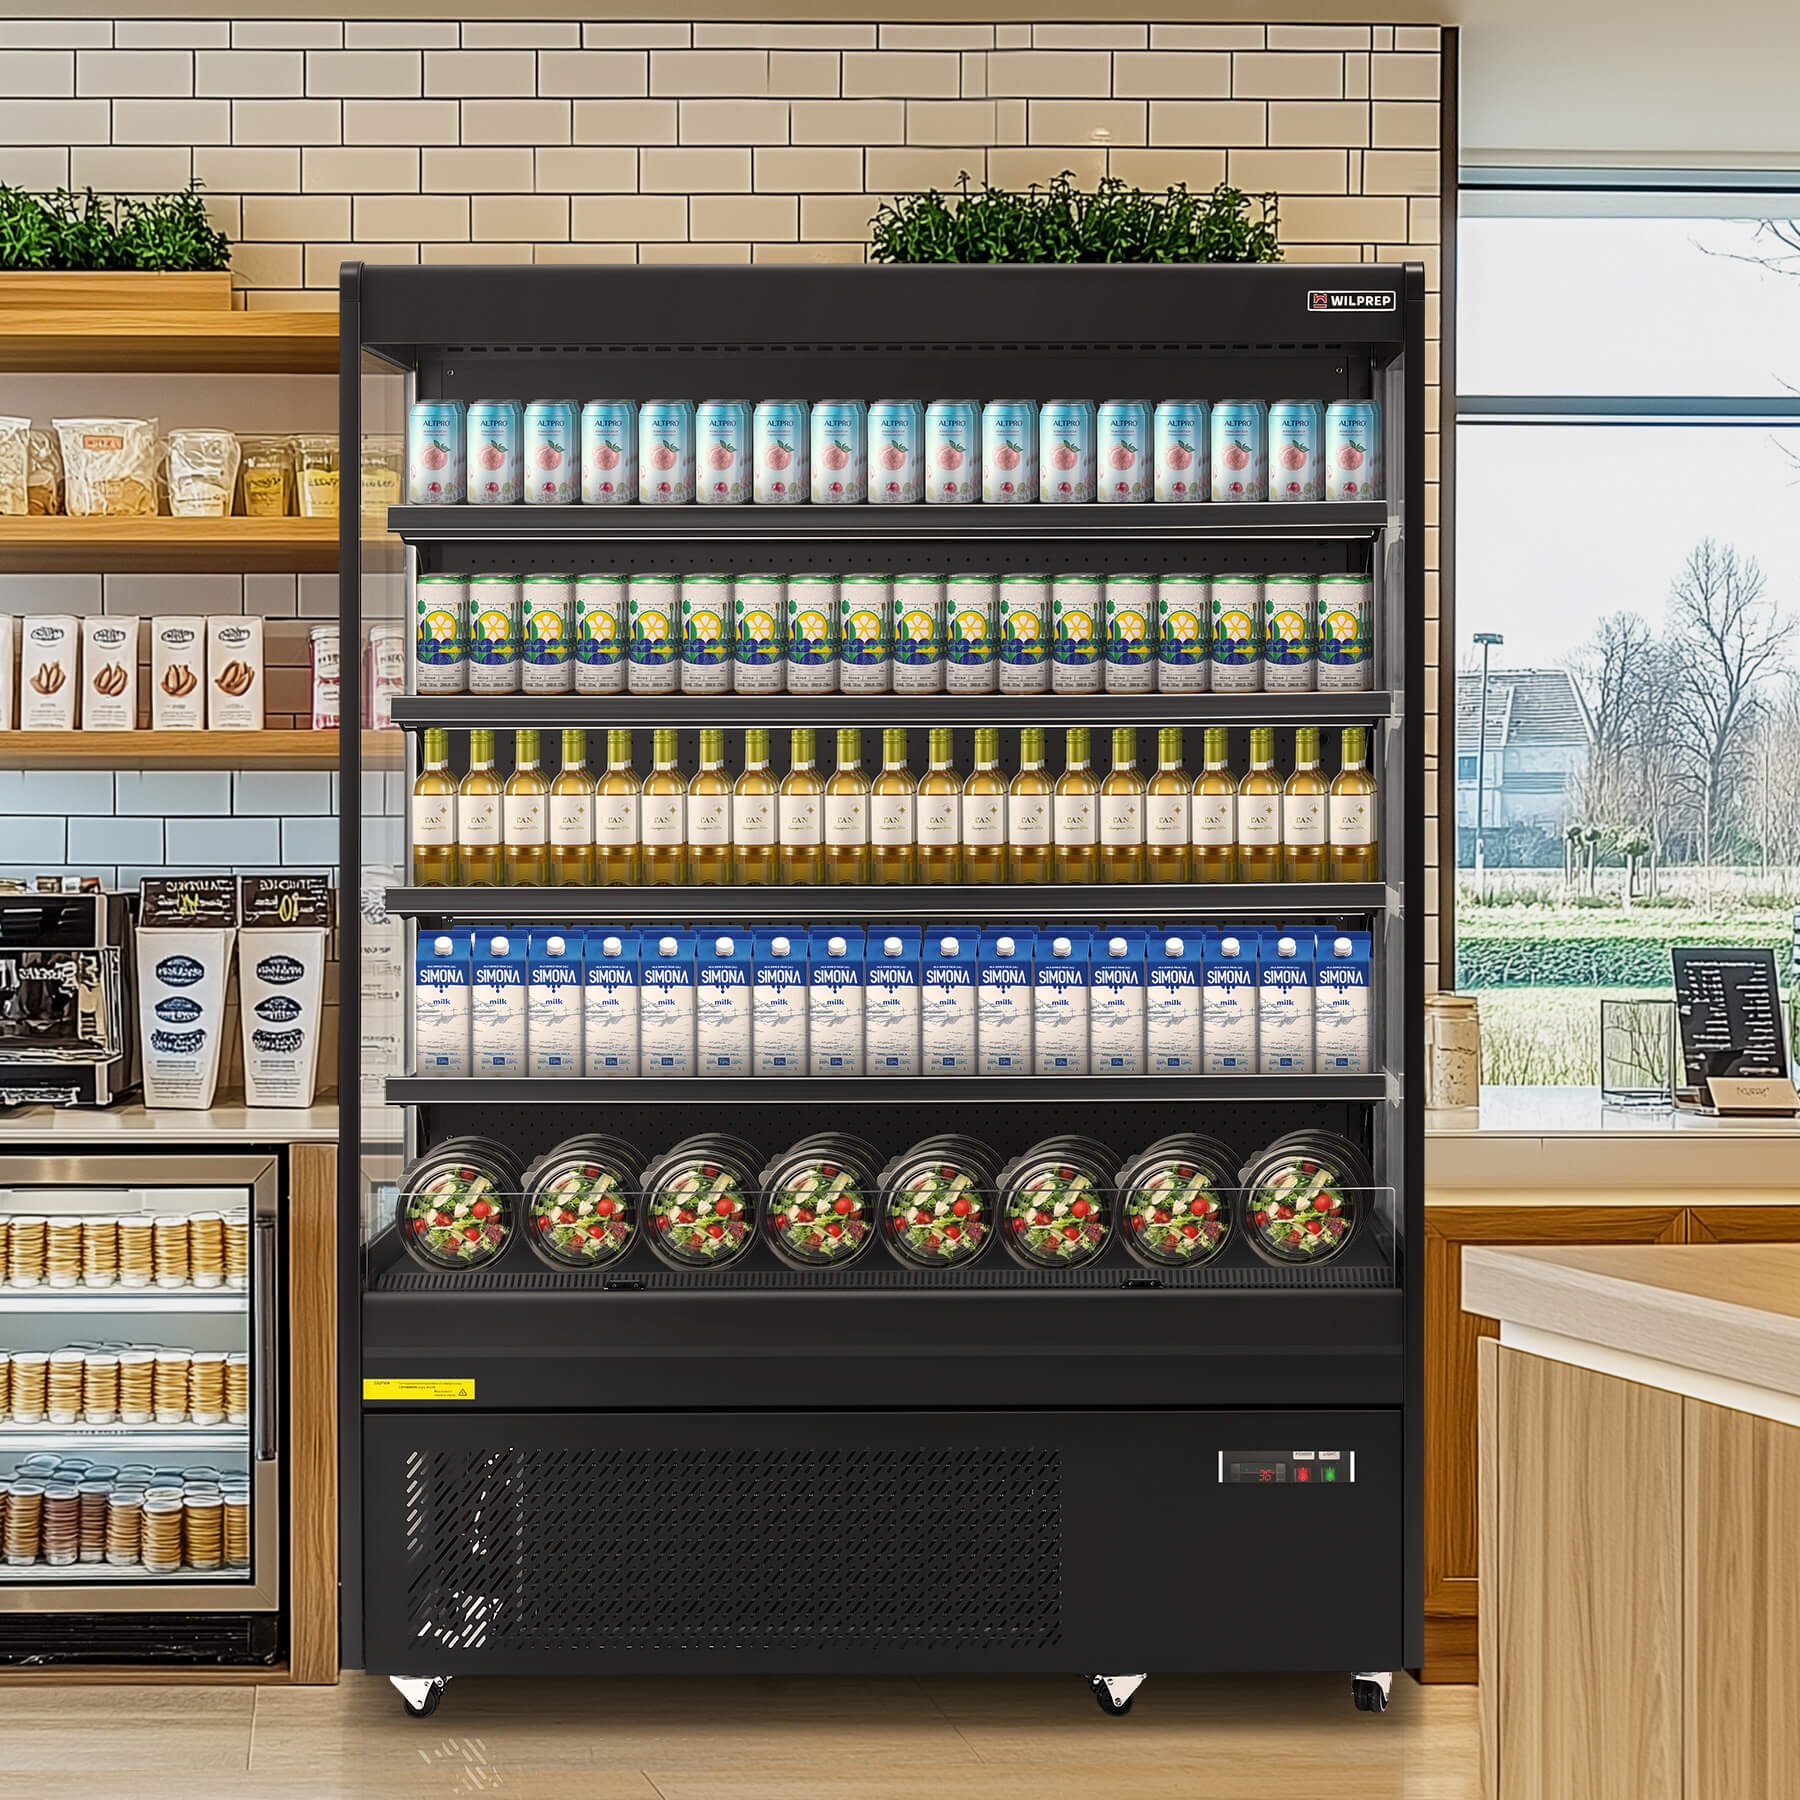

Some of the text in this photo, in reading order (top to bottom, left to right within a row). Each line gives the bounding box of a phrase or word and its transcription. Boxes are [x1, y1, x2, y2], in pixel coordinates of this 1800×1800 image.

[1330, 295, 1391, 306] WILPREP
[423, 419, 450, 427] ALTPRO
[480, 419, 507, 427] ALTPRO
[537, 419, 564, 427] ALTPRO
[595, 419, 622, 427] ALTPRO
[652, 419, 679, 427] ALTPRO
[709, 419, 736, 427] ALTPRO
[767, 419, 794, 427] ALTPRO
[824, 419, 851, 427] ALTPRO
[881, 419, 908, 427] ALTPRO
[939, 419, 966, 427] ALTPRO
[996, 419, 1023, 427] ALTPRO
[1053, 419, 1080, 427] ALTPRO
[1111, 419, 1138, 427] ALTPRO
[1167, 419, 1194, 427] ALTPRO
[1225, 419, 1252, 427] ALTPRO
[1282, 419, 1309, 427] ALTPRO
[1339, 419, 1366, 427] ALTPRO
[420, 969, 464, 983] SIMONA
[476, 969, 520, 983] SIMONA
[532, 969, 576, 983] SIMONA
[589, 970, 633, 984] SIMONA
[645, 970, 689, 984] SIMONA
[701, 969, 745, 983] SIMONA
[757, 969, 801, 983] SIMONA
[814, 970, 858, 984] SIMONA
[870, 970, 914, 984] SIMONA
[926, 969, 970, 983] SIMONA
[982, 969, 1026, 983] SIMONA
[1039, 970, 1083, 984] SIMONA
[1095, 970, 1139, 984] SIMONA
[1151, 970, 1195, 984] SIMONA
[1207, 970, 1251, 984] SIMONA
[1264, 970, 1308, 984] SIMONA
[1320, 970, 1364, 984] SIMONA
